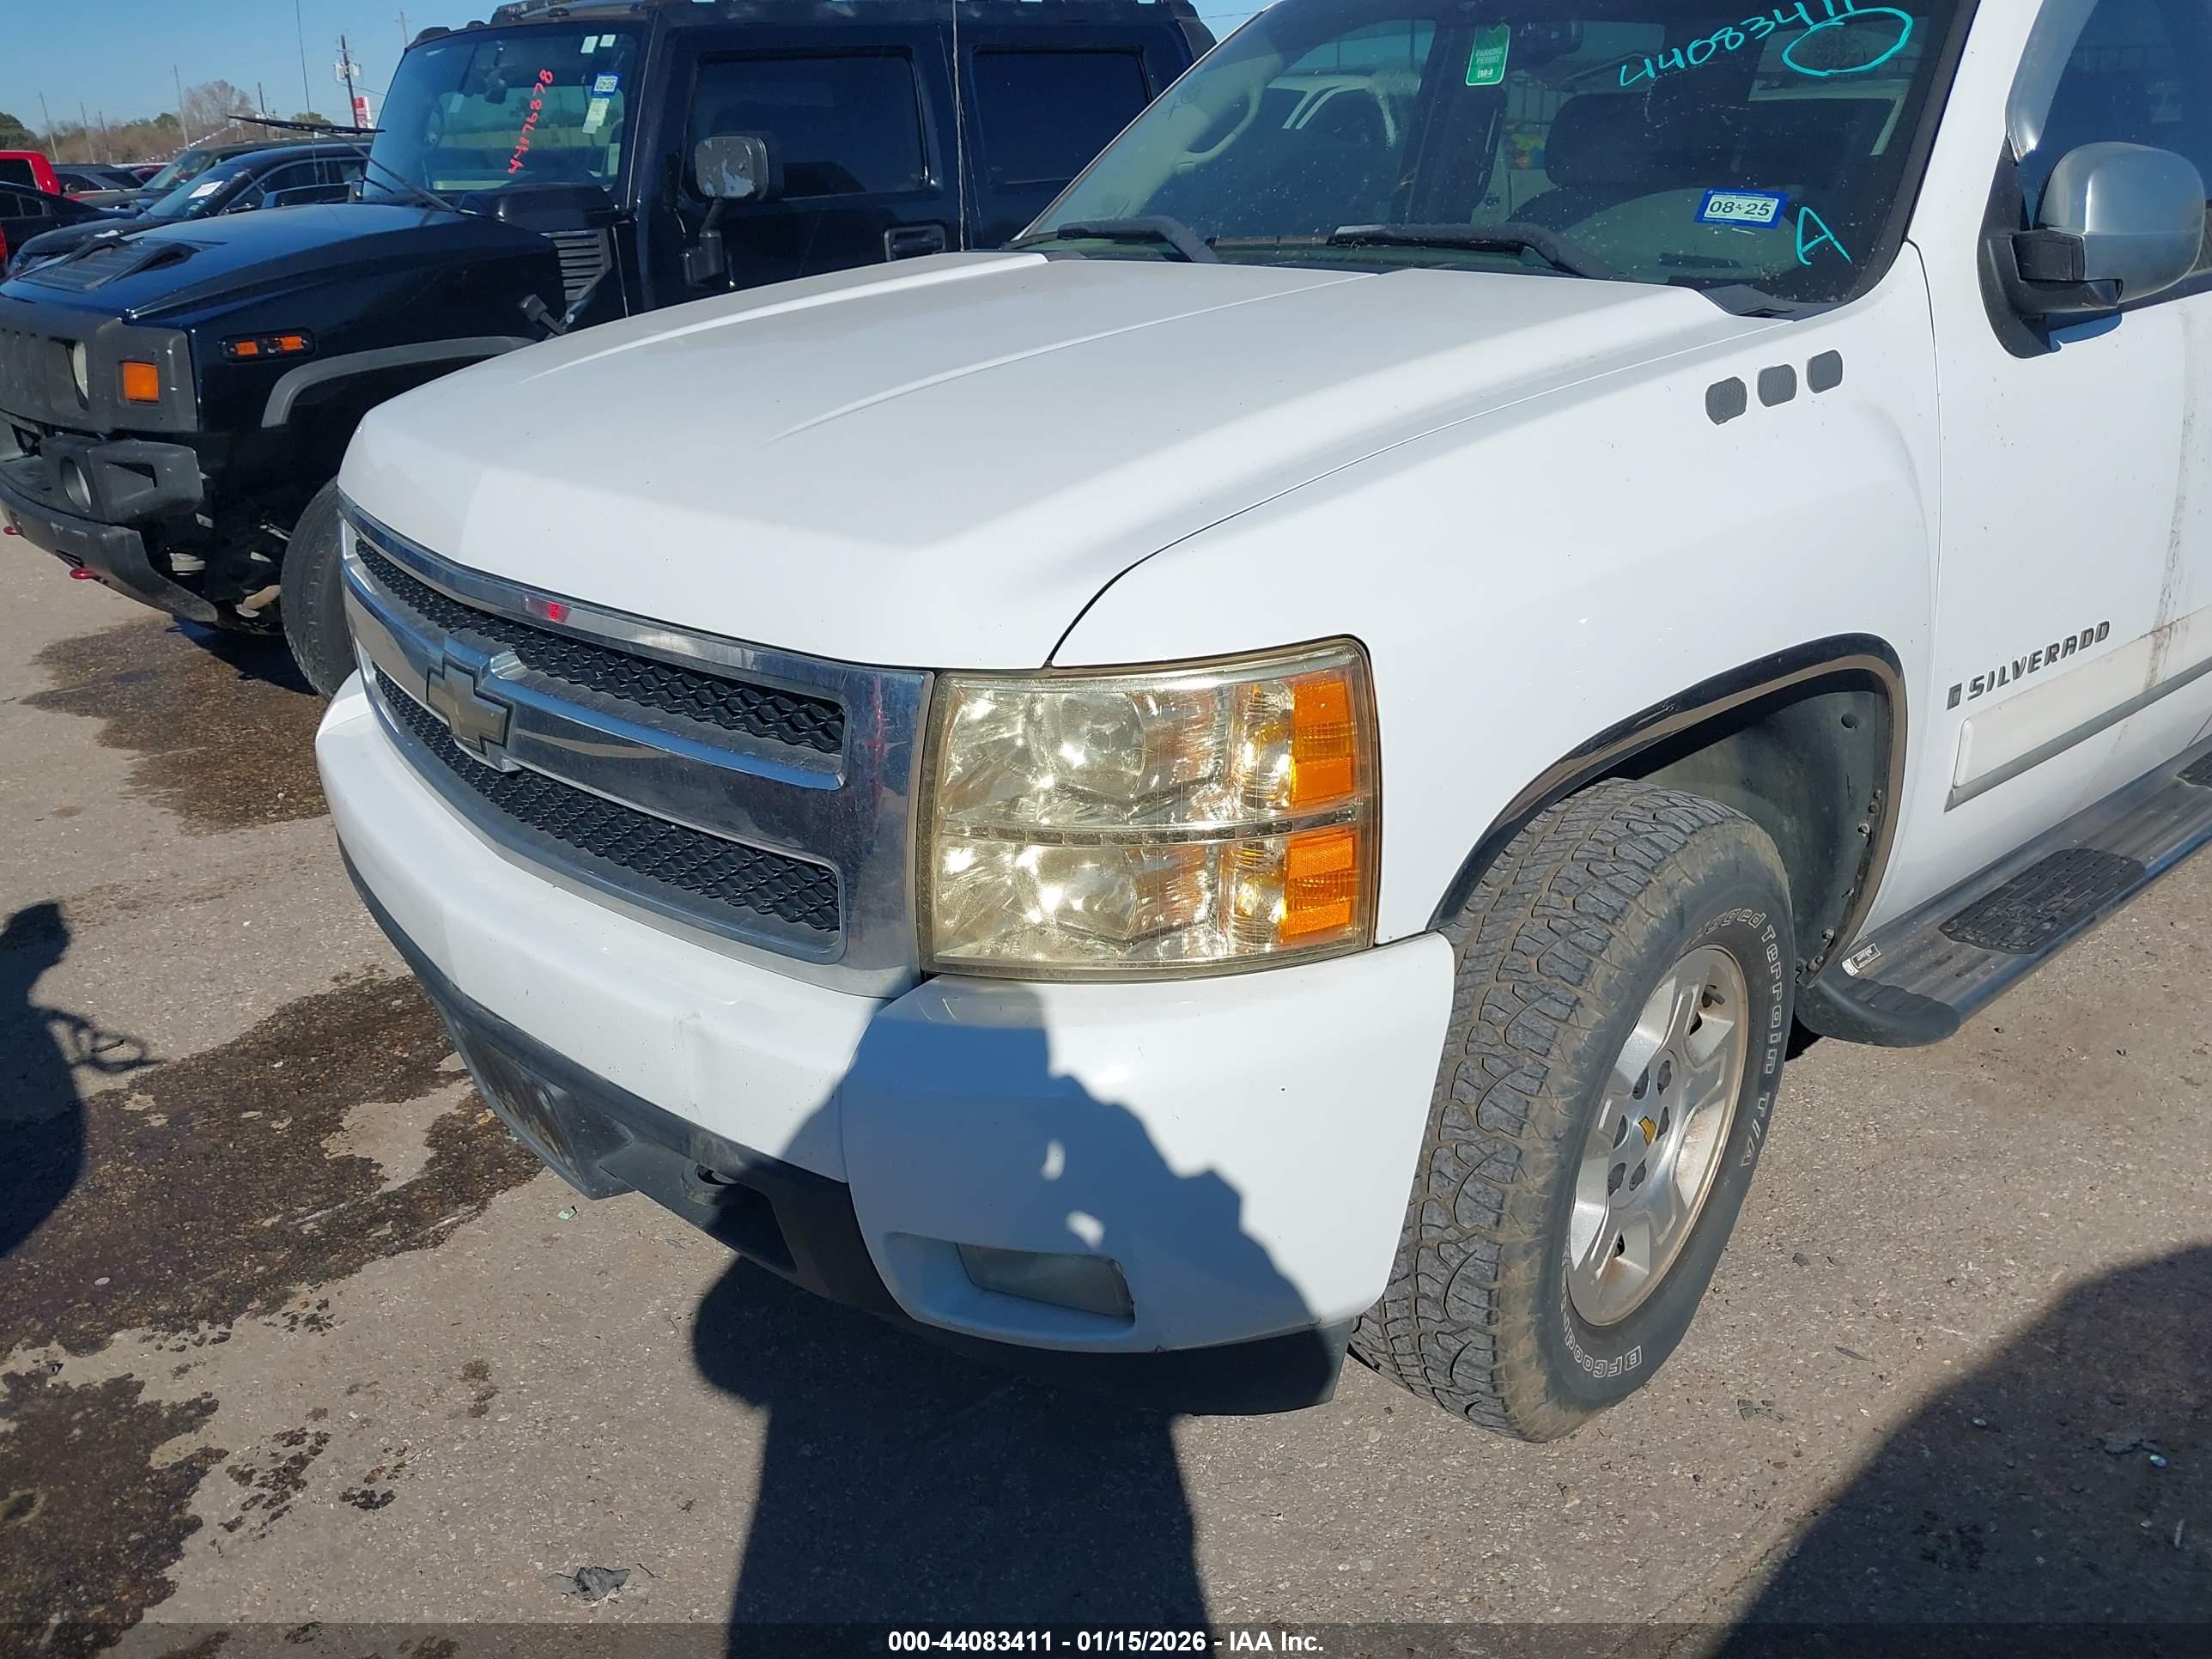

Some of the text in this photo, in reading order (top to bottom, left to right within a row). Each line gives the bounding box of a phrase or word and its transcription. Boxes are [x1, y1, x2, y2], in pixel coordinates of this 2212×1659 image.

[1796, 206, 1853, 265] A
[1967, 621, 2110, 701] SILVERADO
[1761, 925, 1783, 1075] Terrain
